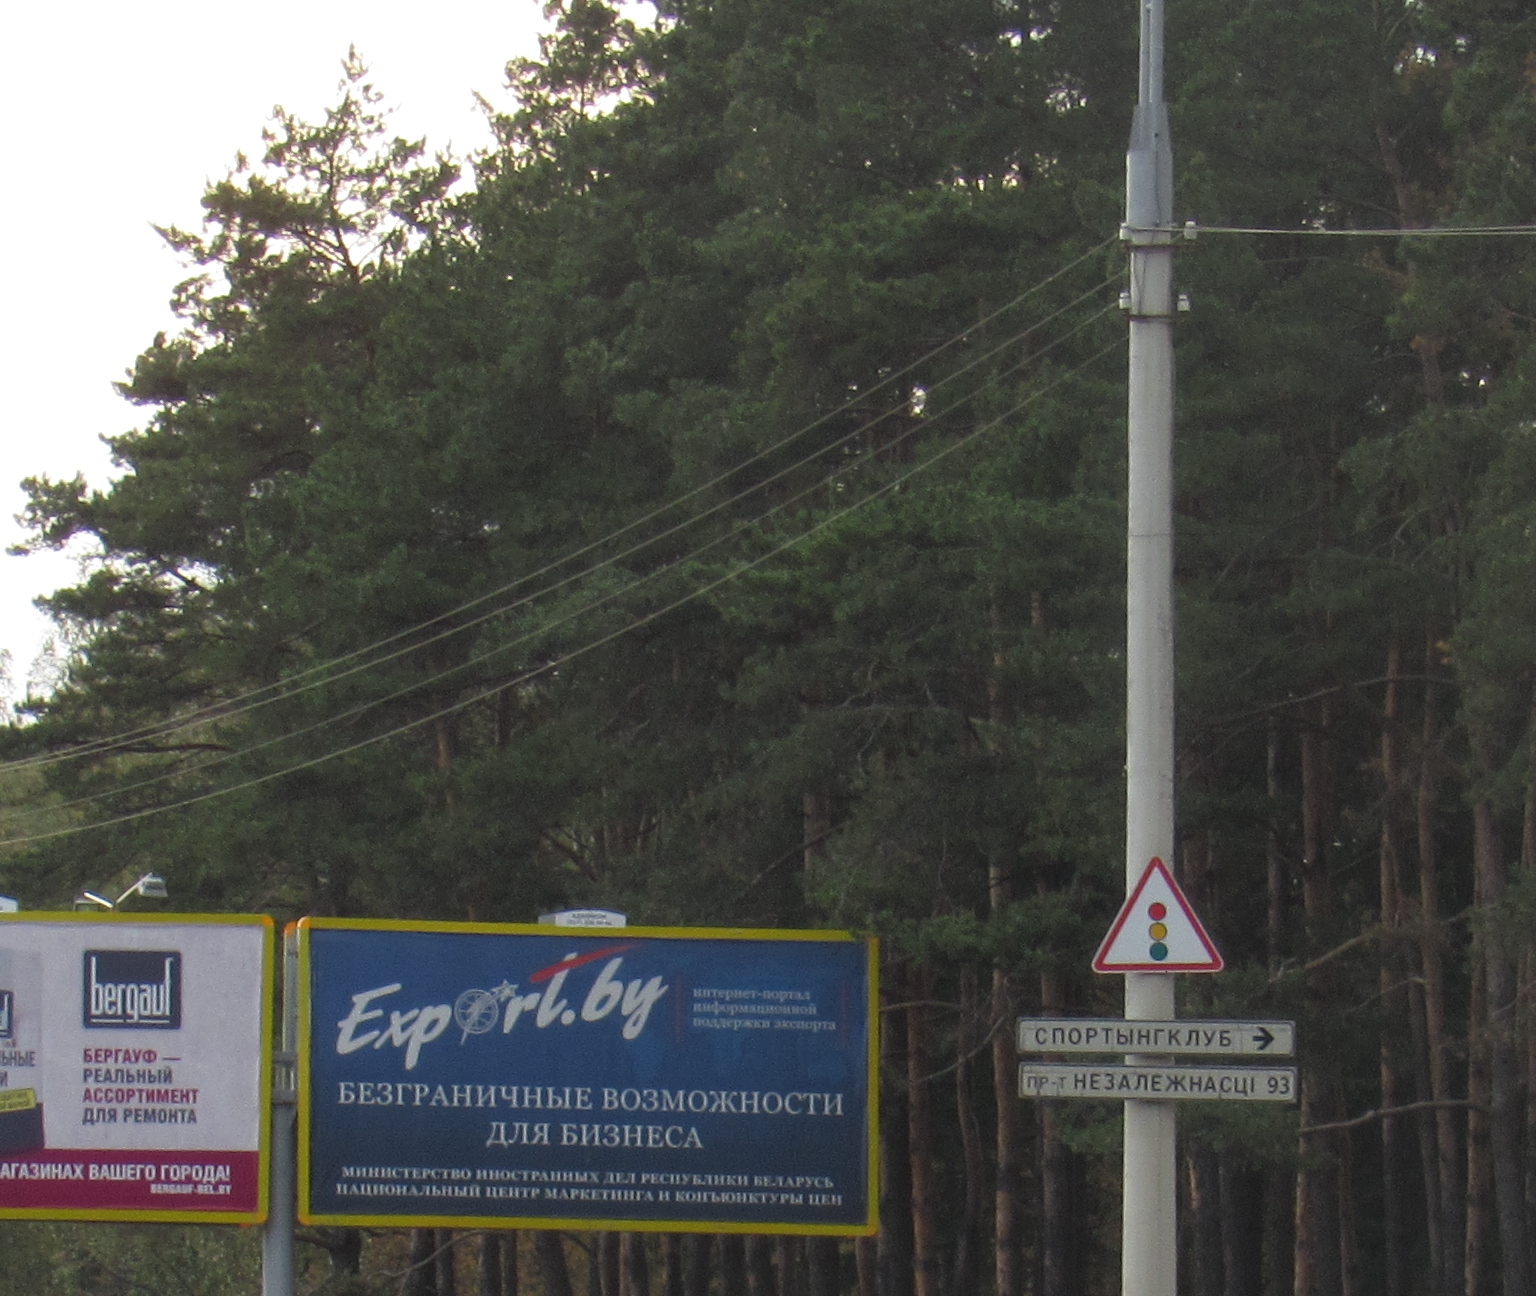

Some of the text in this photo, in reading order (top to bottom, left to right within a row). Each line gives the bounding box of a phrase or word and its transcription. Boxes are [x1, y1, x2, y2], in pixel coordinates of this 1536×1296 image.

[90, 956, 174, 1024] bergauf
[692, 988, 811, 1002] интернет-портал
[692, 1001, 817, 1016] информационной
[692, 1017, 837, 1033] поддержки экспорта
[1034, 1026, 1232, 1048] СПОРТЫНГКЛУБ
[83, 1048, 158, 1064] БЕРГАУФ
[83, 1065, 174, 1085] РЕАЛЬНЫЙ
[1073, 1073, 1256, 1095] НЕЗАЛЕЖНАСЦІ
[1266, 1076, 1291, 1095] 93
[82, 1087, 200, 1105] АССОРТИМЕНТ
[337, 1081, 845, 1117] БЕЗГРАНИЧНЫЕ ВОЗМОЖНОСТИ
[81, 1106, 198, 1126] ДЛЯ РЕМОНТА
[485, 1121, 704, 1149] ДЛЯ БИЗНЕСА
[89, 1163, 157, 1182] ВАШЕГО
[161, 1164, 231, 1184] ГОРОДА!
[341, 1165, 835, 1189] МИНИСТЕРСТВО ИНОСТРАННЫХ ДЕЛ РЕСПУБЛИКИ БЕЛАРУСЬ
[336, 1182, 843, 1207] НАЦИОНАЛЬНЫЙ ЦЕНТР МАРКЕТИНГА И КОНЪЮНКТУРЫ ЦЕН
